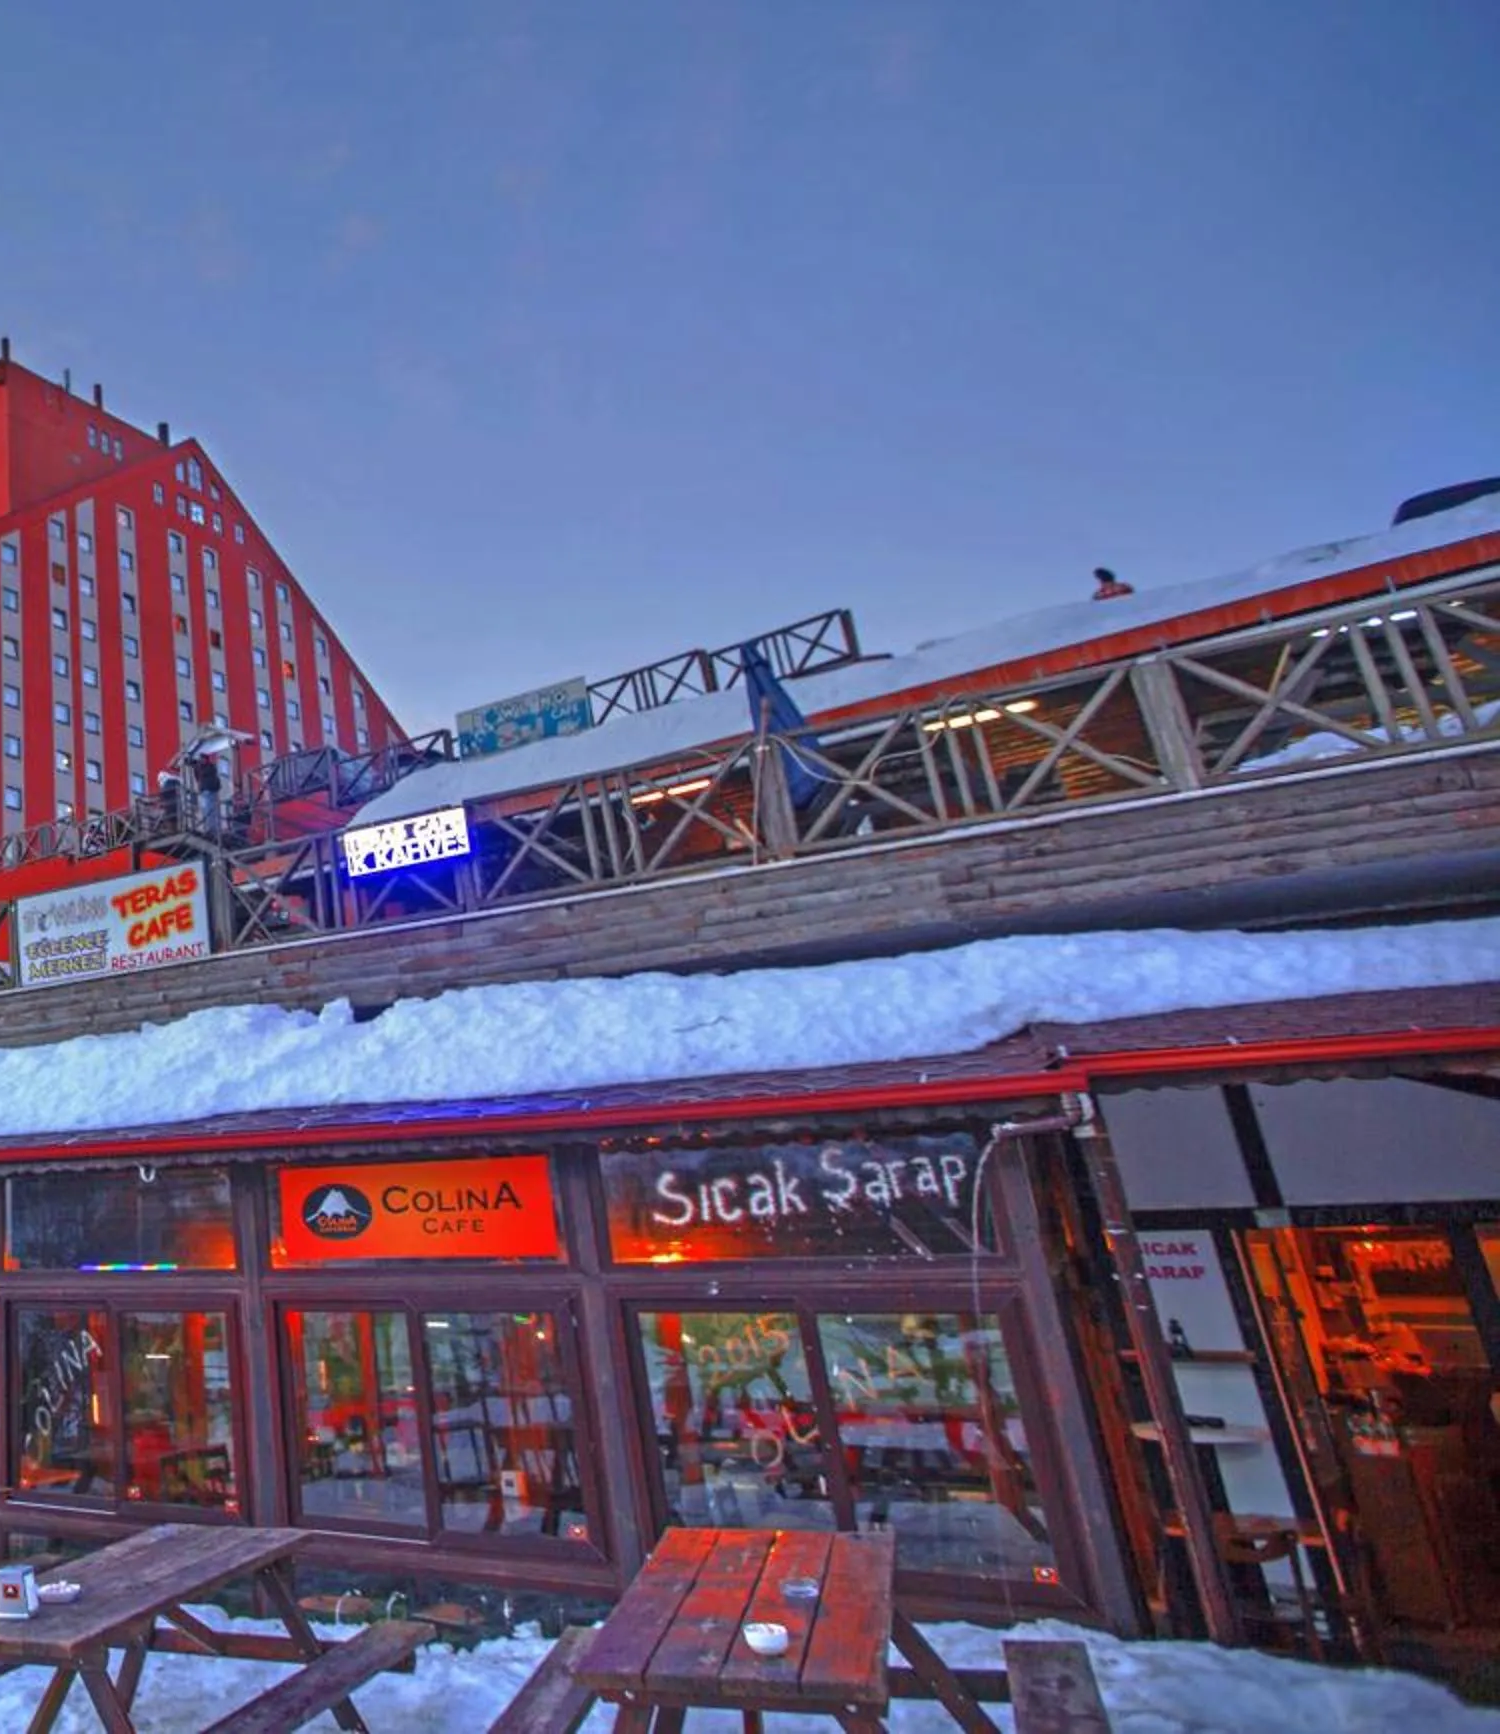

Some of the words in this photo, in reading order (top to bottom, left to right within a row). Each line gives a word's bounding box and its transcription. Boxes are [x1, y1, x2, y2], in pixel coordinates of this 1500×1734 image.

[111, 869, 197, 918] TERAS
[127, 903, 192, 948] CAFE
[111, 942, 205, 970] RESTAURANT
[381, 1180, 522, 1214] COLINA
[422, 1217, 485, 1234] CAFE
[1142, 1241, 1198, 1256] ICAK
[1147, 1265, 1206, 1279] ARAP
